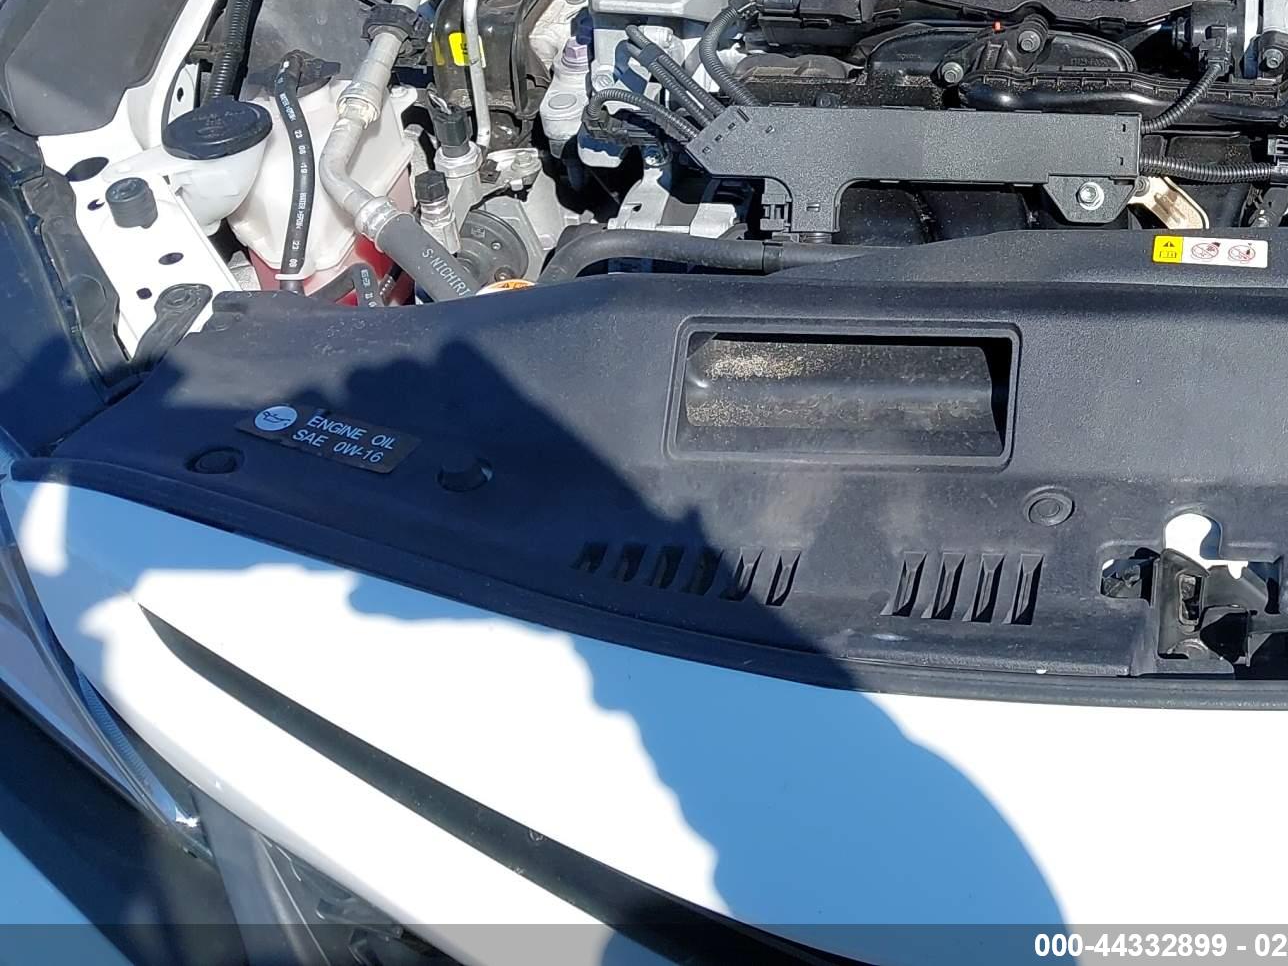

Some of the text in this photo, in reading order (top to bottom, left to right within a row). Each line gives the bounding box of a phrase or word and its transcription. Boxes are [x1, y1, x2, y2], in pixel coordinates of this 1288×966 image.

[291, 429, 384, 463] SAE 0W-16
[306, 415, 396, 450] ENGINE OIL
